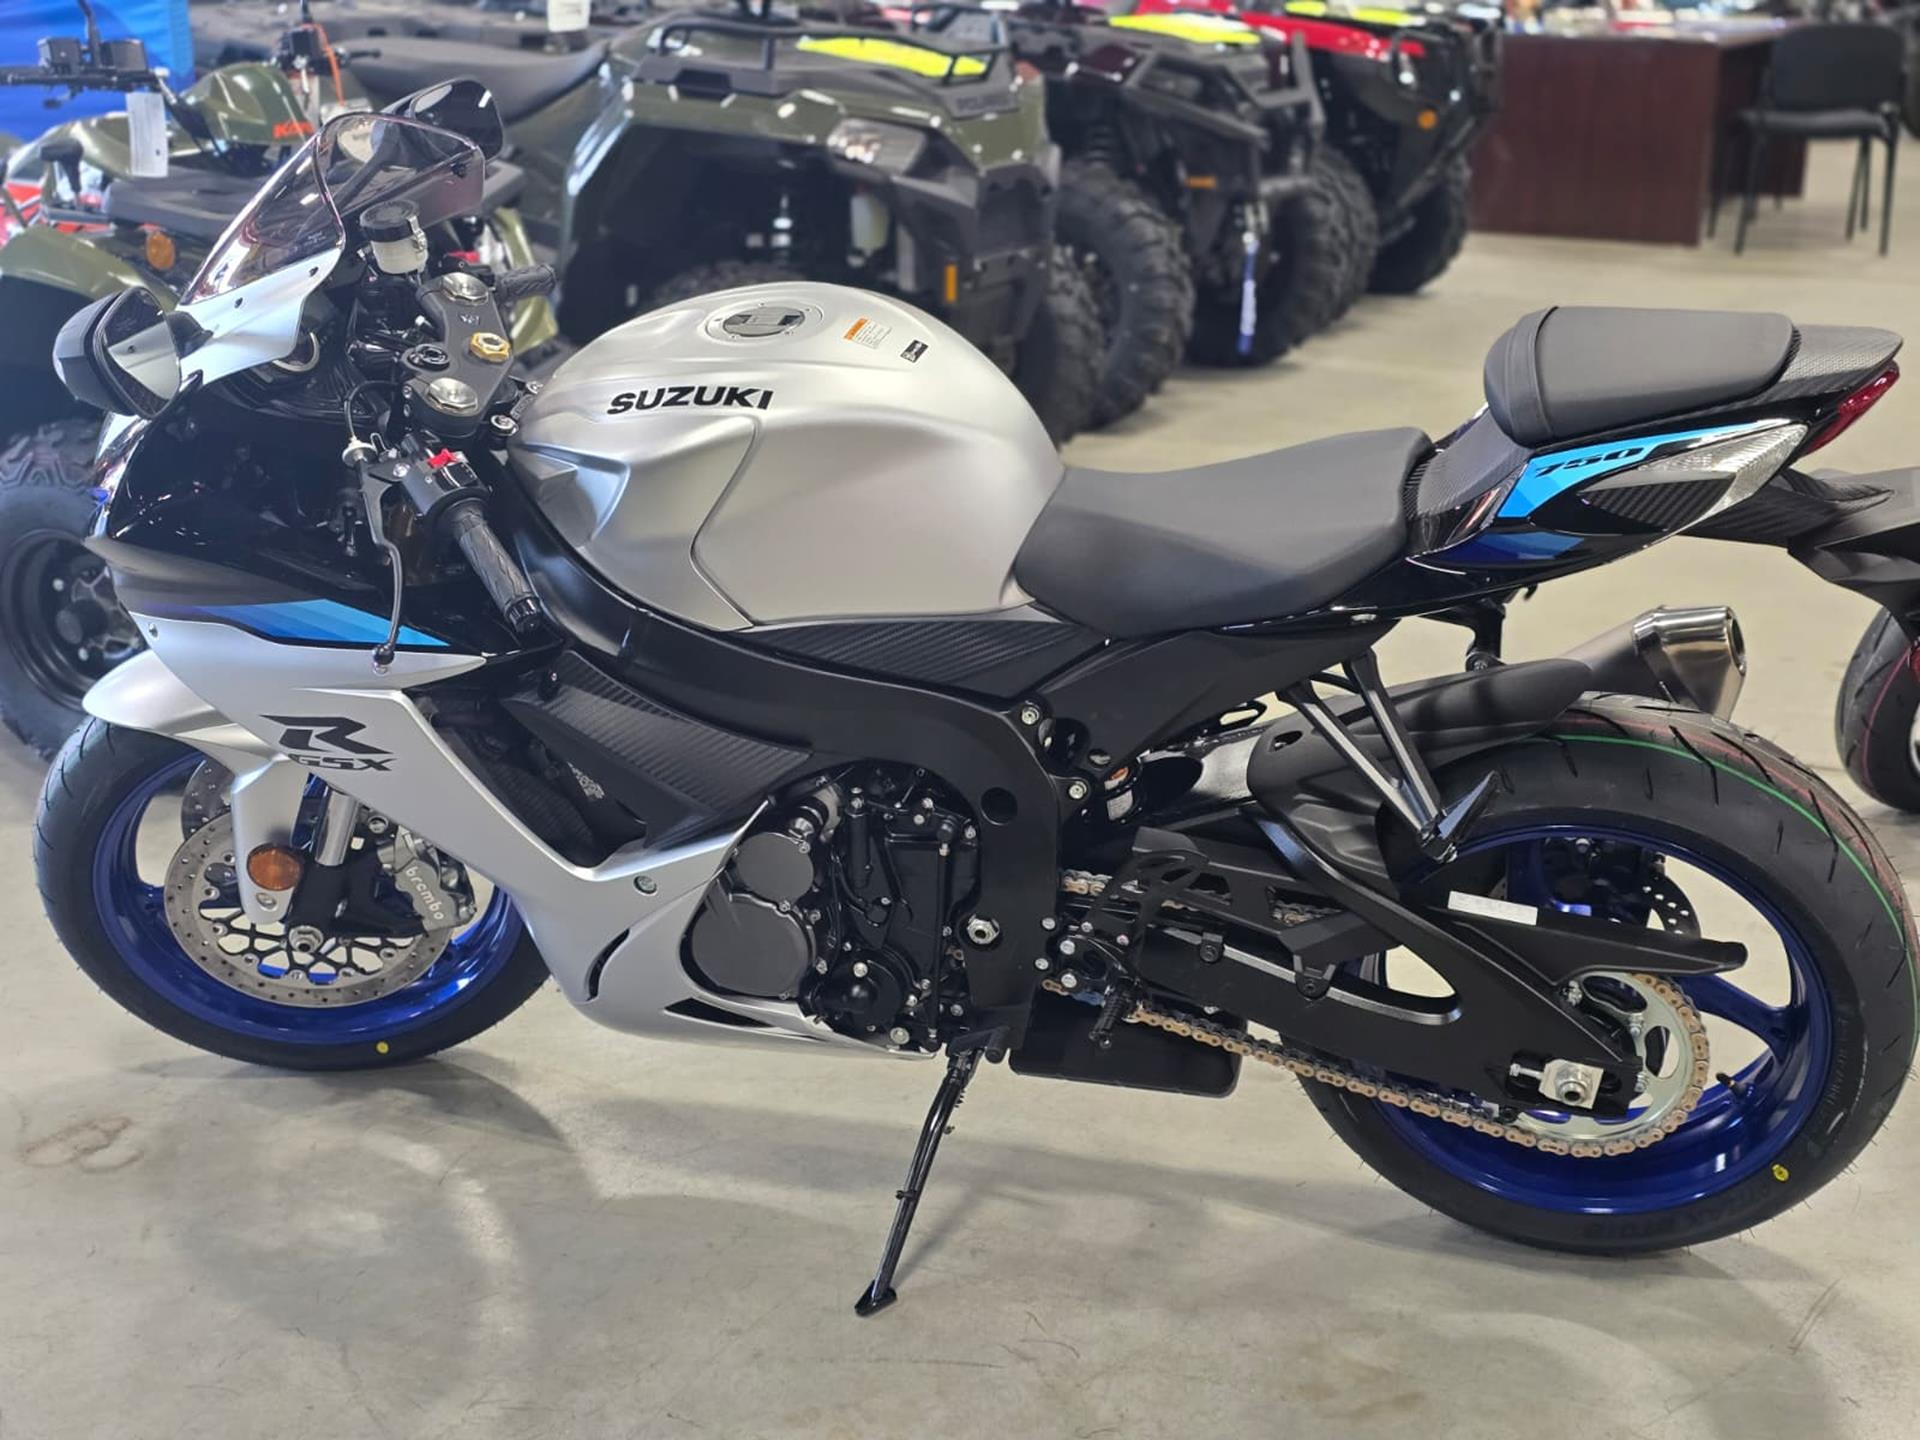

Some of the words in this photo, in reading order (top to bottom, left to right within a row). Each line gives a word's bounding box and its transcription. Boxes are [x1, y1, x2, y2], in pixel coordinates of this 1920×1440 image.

[607, 386, 774, 415] SUZUKI
[1535, 446, 1645, 477] 750
[259, 715, 394, 754] R
[288, 754, 398, 771] GSX
[406, 866, 444, 920] brembo
